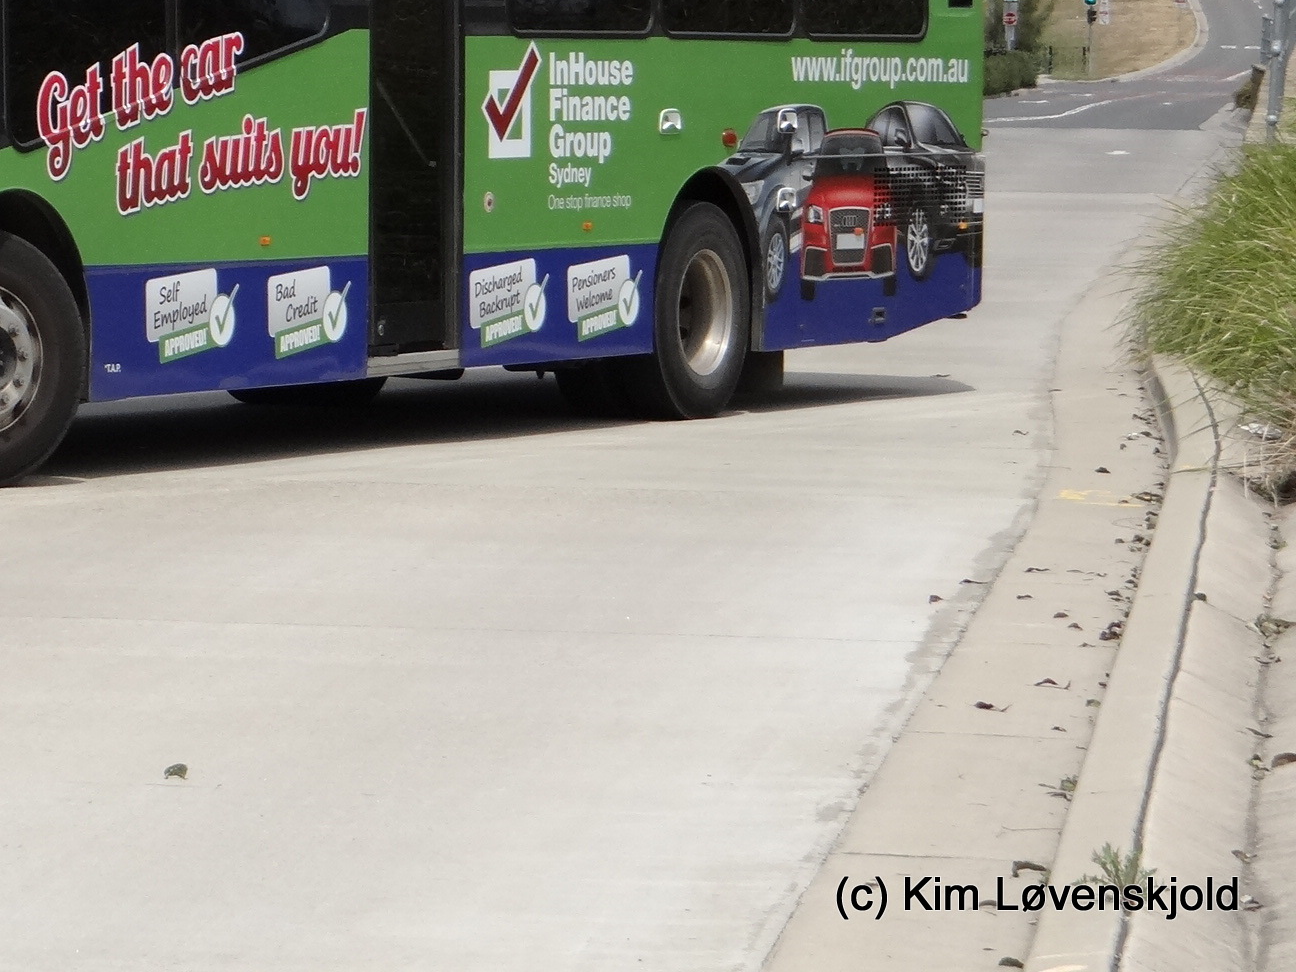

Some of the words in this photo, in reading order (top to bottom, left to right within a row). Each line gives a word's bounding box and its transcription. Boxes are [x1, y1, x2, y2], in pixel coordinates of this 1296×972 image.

[549, 51, 634, 86] InHouse
[791, 49, 969, 89] www.ifgroup.com.au
[37, 62, 104, 181] Get
[110, 42, 174, 131] the
[180, 31, 245, 105] car
[549, 88, 631, 122] Finance
[549, 124, 612, 164] Group
[116, 129, 193, 215] that
[199, 113, 285, 194] suits
[289, 108, 368, 200] you!
[548, 162, 592, 189] Sydney
[547, 194, 565, 210] One
[565, 195, 584, 211] stop
[584, 193, 612, 208] finance
[612, 192, 632, 210] shop
[159, 280, 181, 305] Self
[275, 278, 297, 302] Bad
[474, 265, 523, 299] Discharged
[572, 267, 616, 293] Pensioners
[153, 293, 208, 331] Employed
[285, 295, 319, 323] Credit
[479, 289, 521, 319] Backrupt
[576, 288, 613, 312] Welcome
